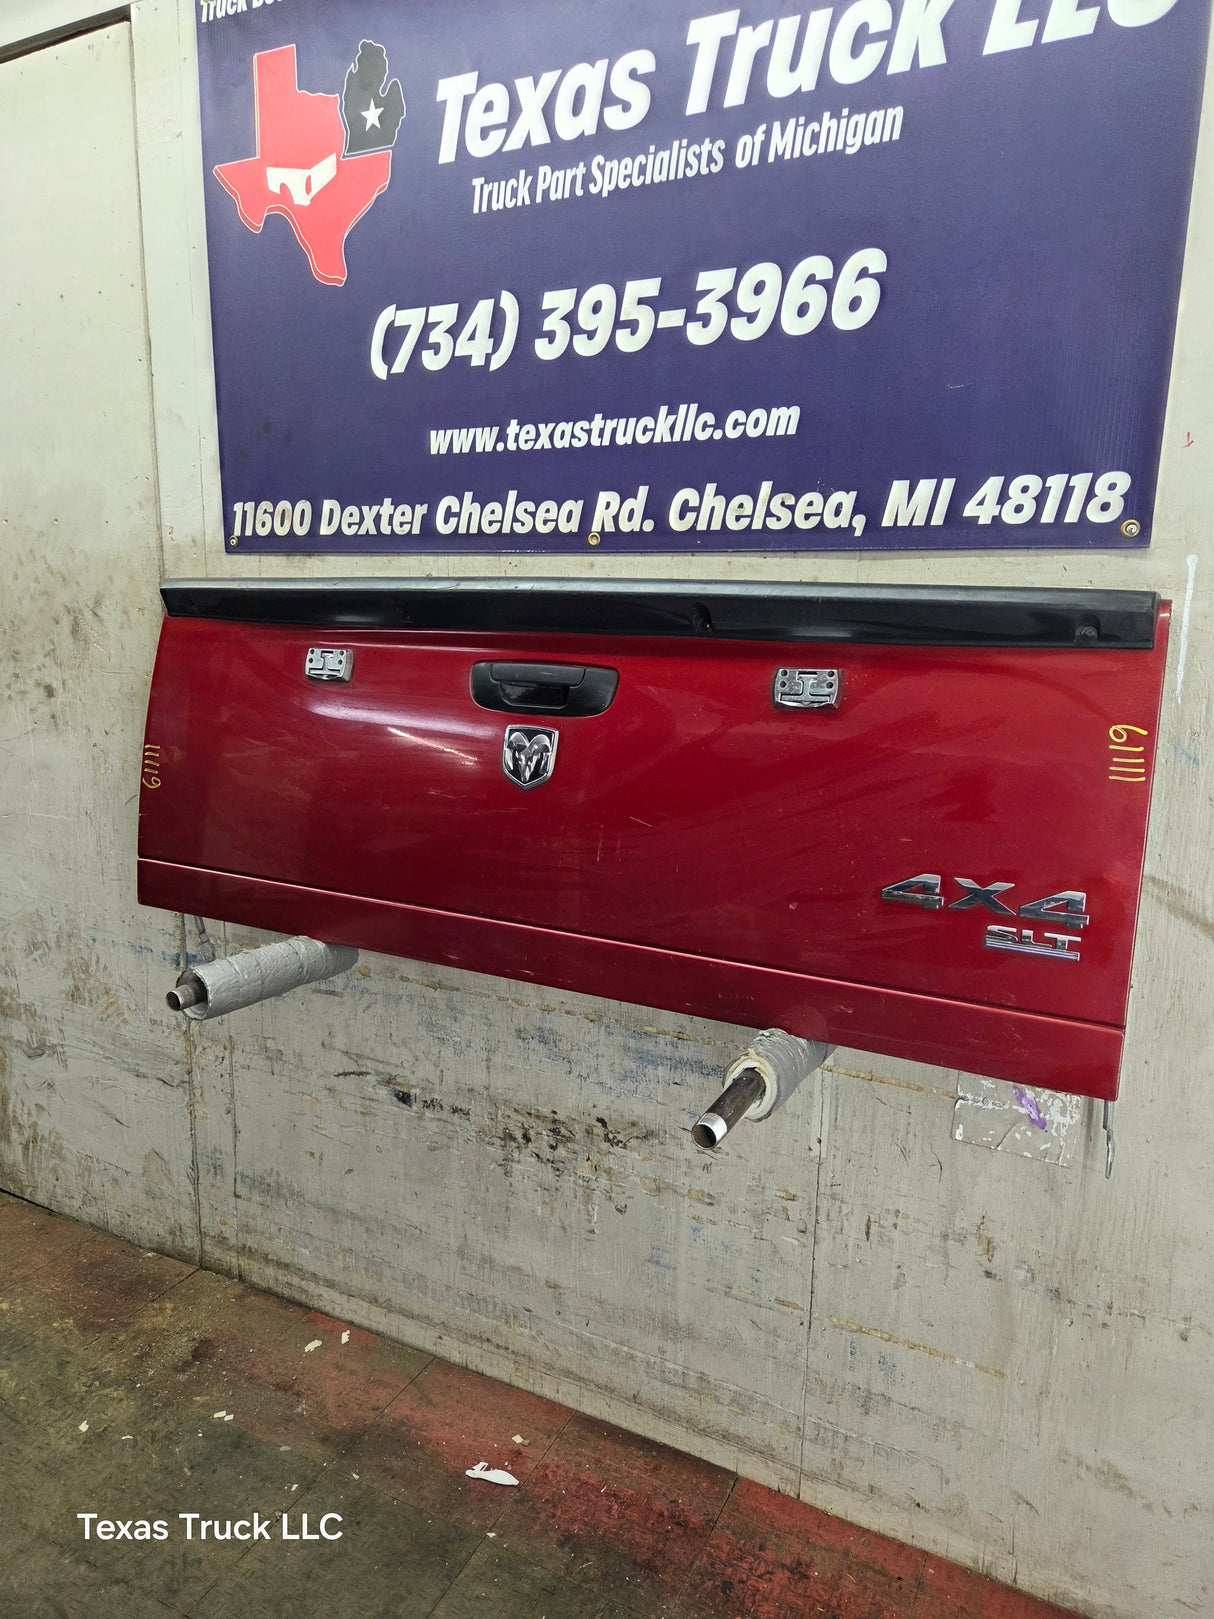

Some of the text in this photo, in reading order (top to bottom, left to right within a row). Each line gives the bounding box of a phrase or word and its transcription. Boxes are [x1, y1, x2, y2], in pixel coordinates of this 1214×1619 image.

[434, 0, 1178, 166] Texas Truck LL
[471, 104, 904, 214] Truck Part Specialists of Michigan
[370, 247, 888, 381] (734) 395-3966
[429, 403, 801, 455] www.texastruckllc.com
[231, 470, 1133, 538] 11600 Dexter Chelsea Rd. Chelsea, MI 48118
[984, 924, 1082, 955] SLT
